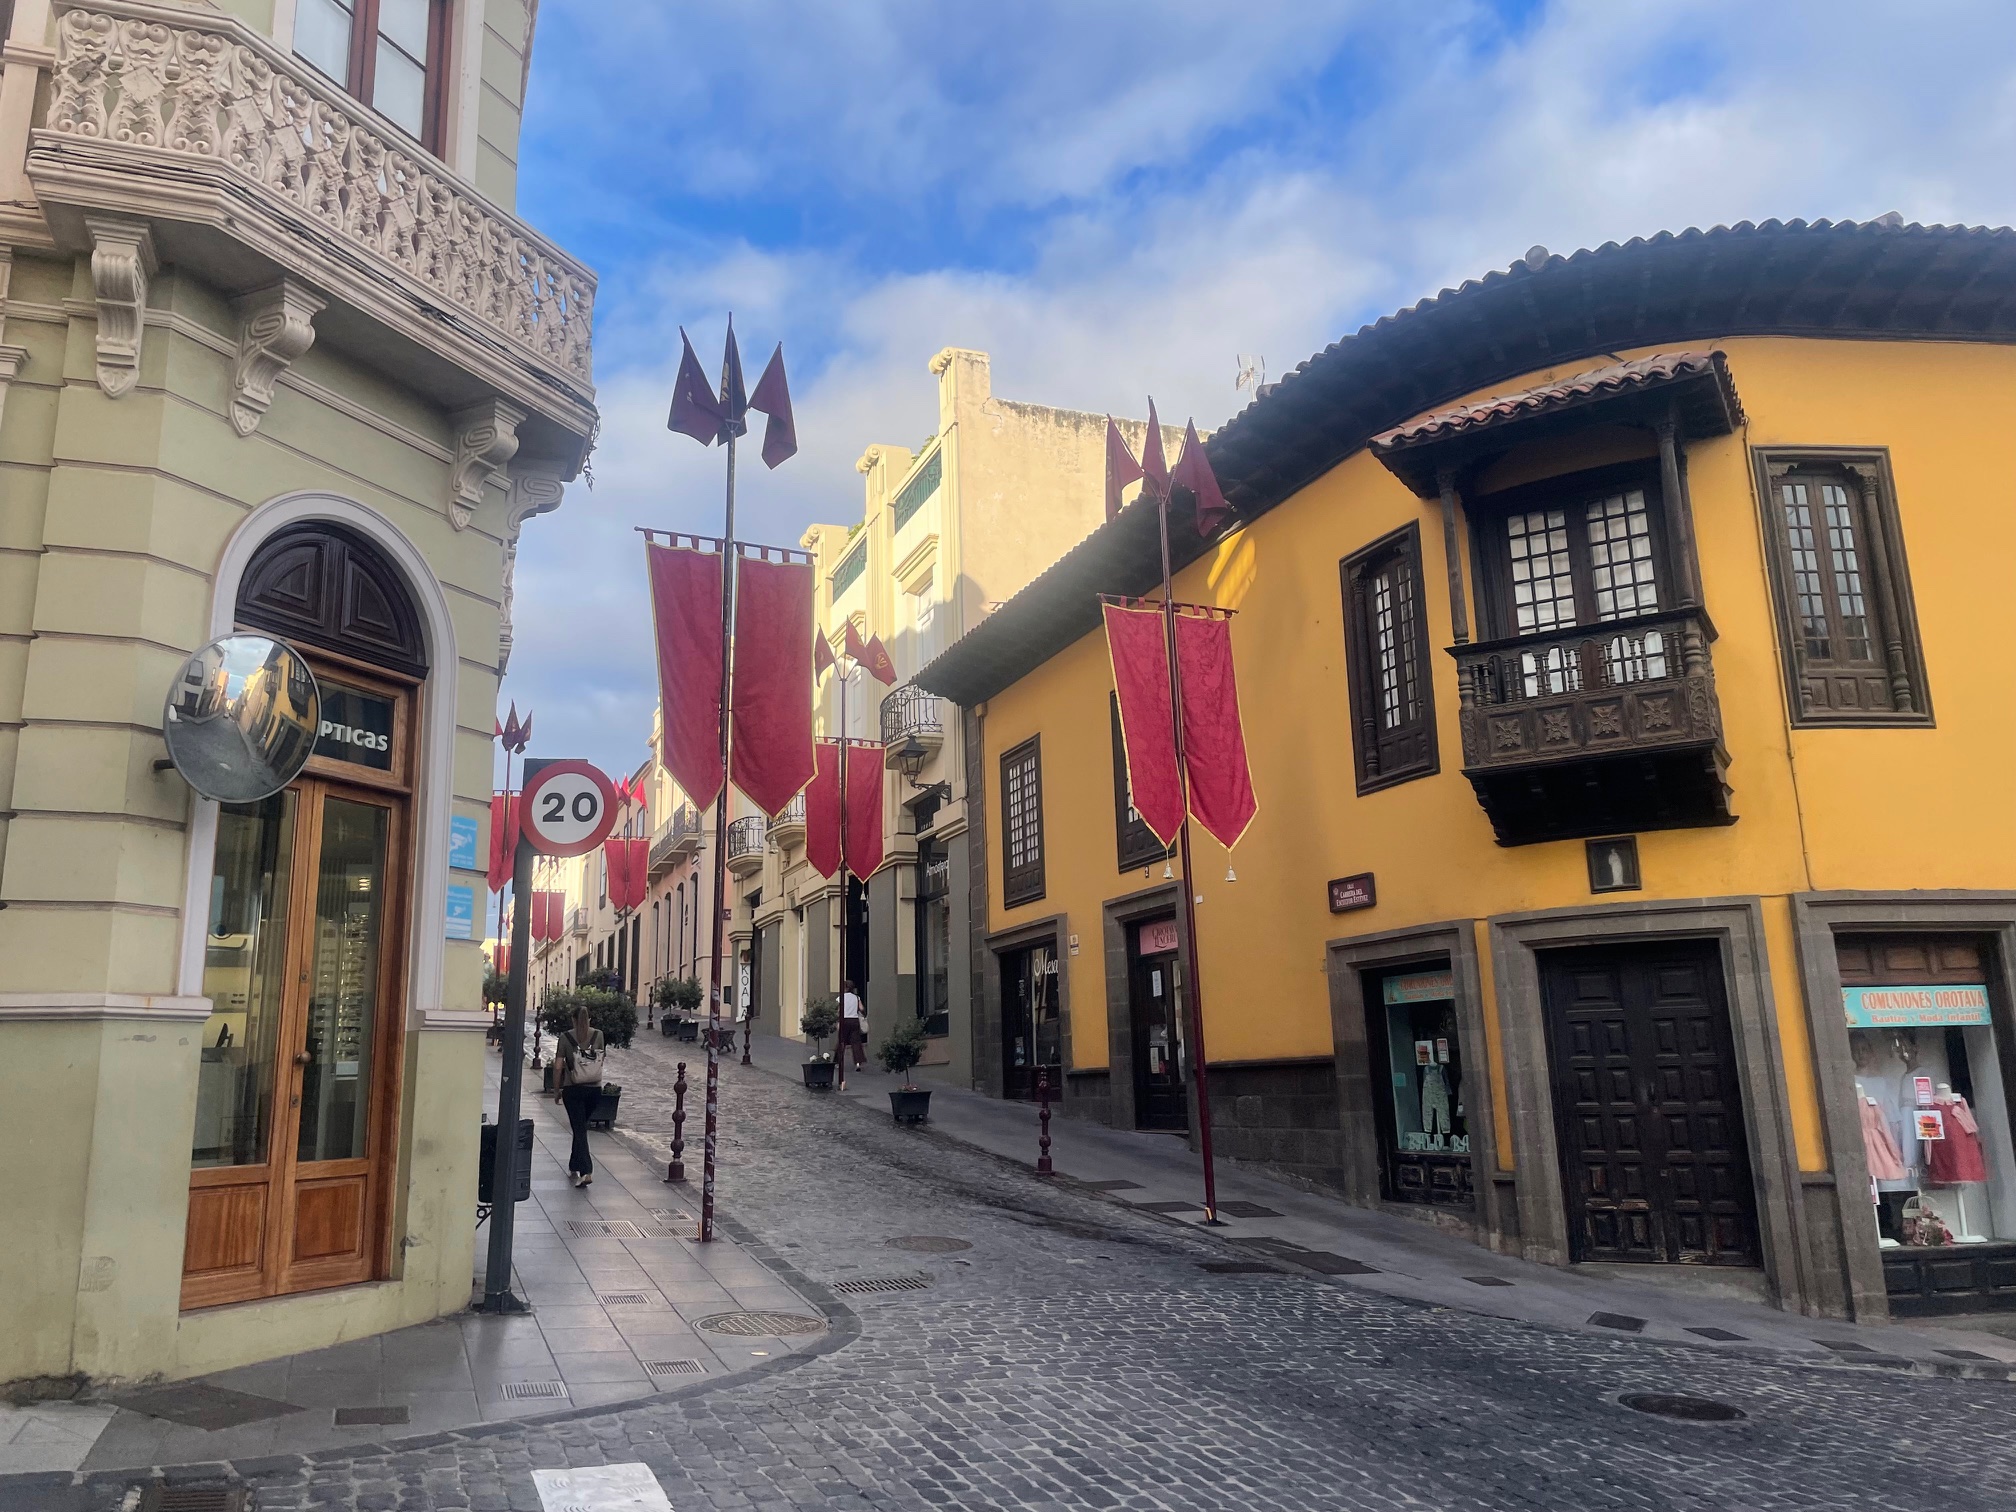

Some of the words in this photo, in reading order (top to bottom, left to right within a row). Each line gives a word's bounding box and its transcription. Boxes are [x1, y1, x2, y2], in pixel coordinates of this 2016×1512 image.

[320, 720, 388, 752] PTICas
[542, 791, 598, 822] 20
[1355, 888, 1363, 896] DEL
[1861, 992, 1932, 1010] COMUNIONES
[1934, 990, 1985, 1008] OROTAVA
[1871, 1014, 1908, 1023] Bautizo
[1919, 1013, 1943, 1022] Moda
[1947, 1012, 1981, 1021] Infantil
